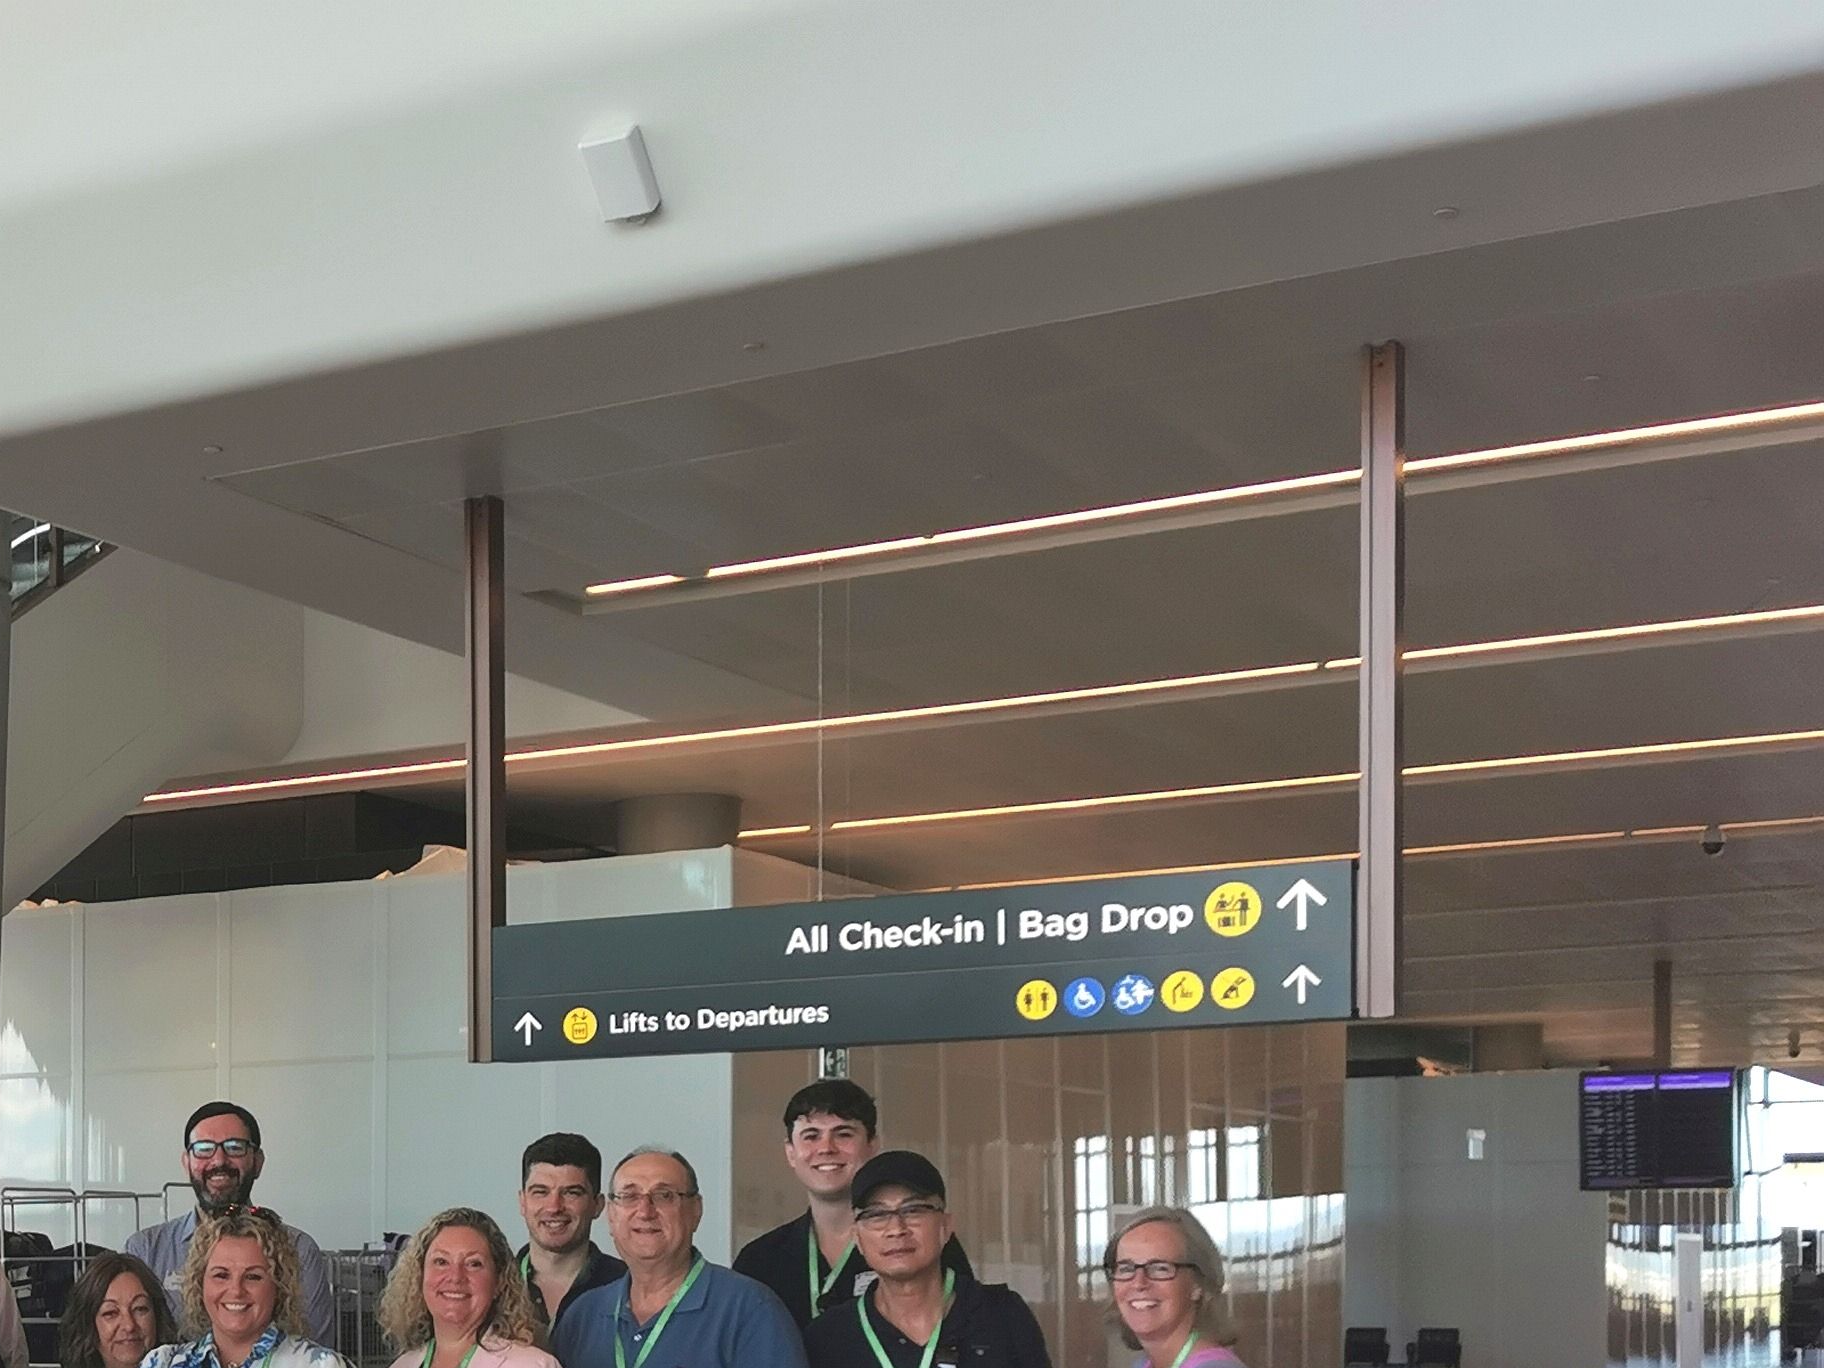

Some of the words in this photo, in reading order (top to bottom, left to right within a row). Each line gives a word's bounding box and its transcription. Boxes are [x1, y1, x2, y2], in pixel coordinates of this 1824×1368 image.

[784, 924, 829, 956] All
[837, 914, 986, 952] Check-in
[1017, 908, 1090, 942] Bag
[1099, 902, 1195, 935] Drop
[608, 1010, 660, 1035] Lifts
[664, 1010, 692, 1032] to
[696, 1003, 831, 1033] Departures
